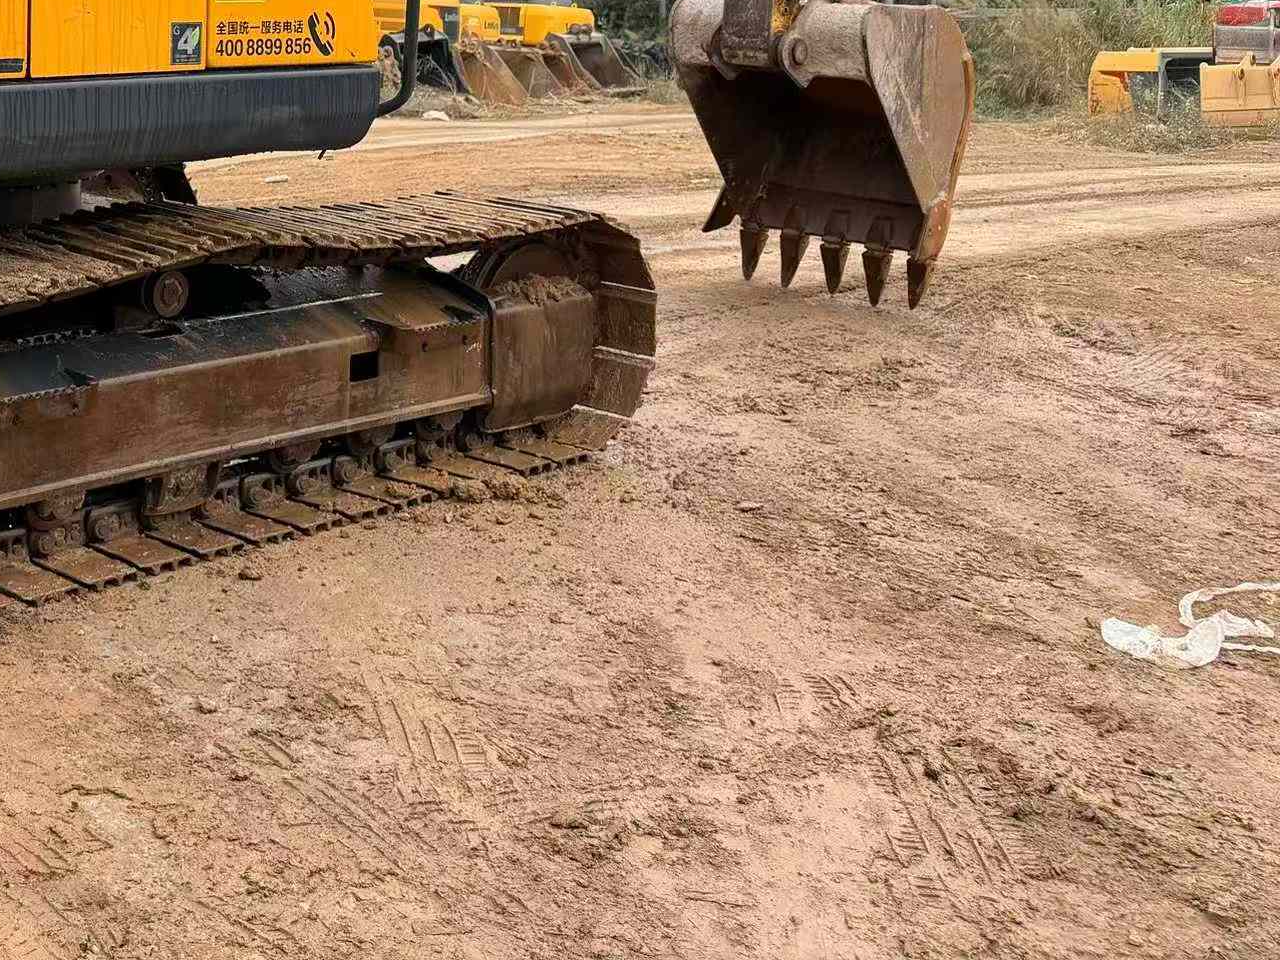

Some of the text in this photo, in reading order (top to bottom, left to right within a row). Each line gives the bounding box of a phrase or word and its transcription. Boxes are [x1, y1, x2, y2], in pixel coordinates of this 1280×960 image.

[216, 20, 304, 35] 全国统一服务电话
[216, 37, 311, 56] 400 8899 856
